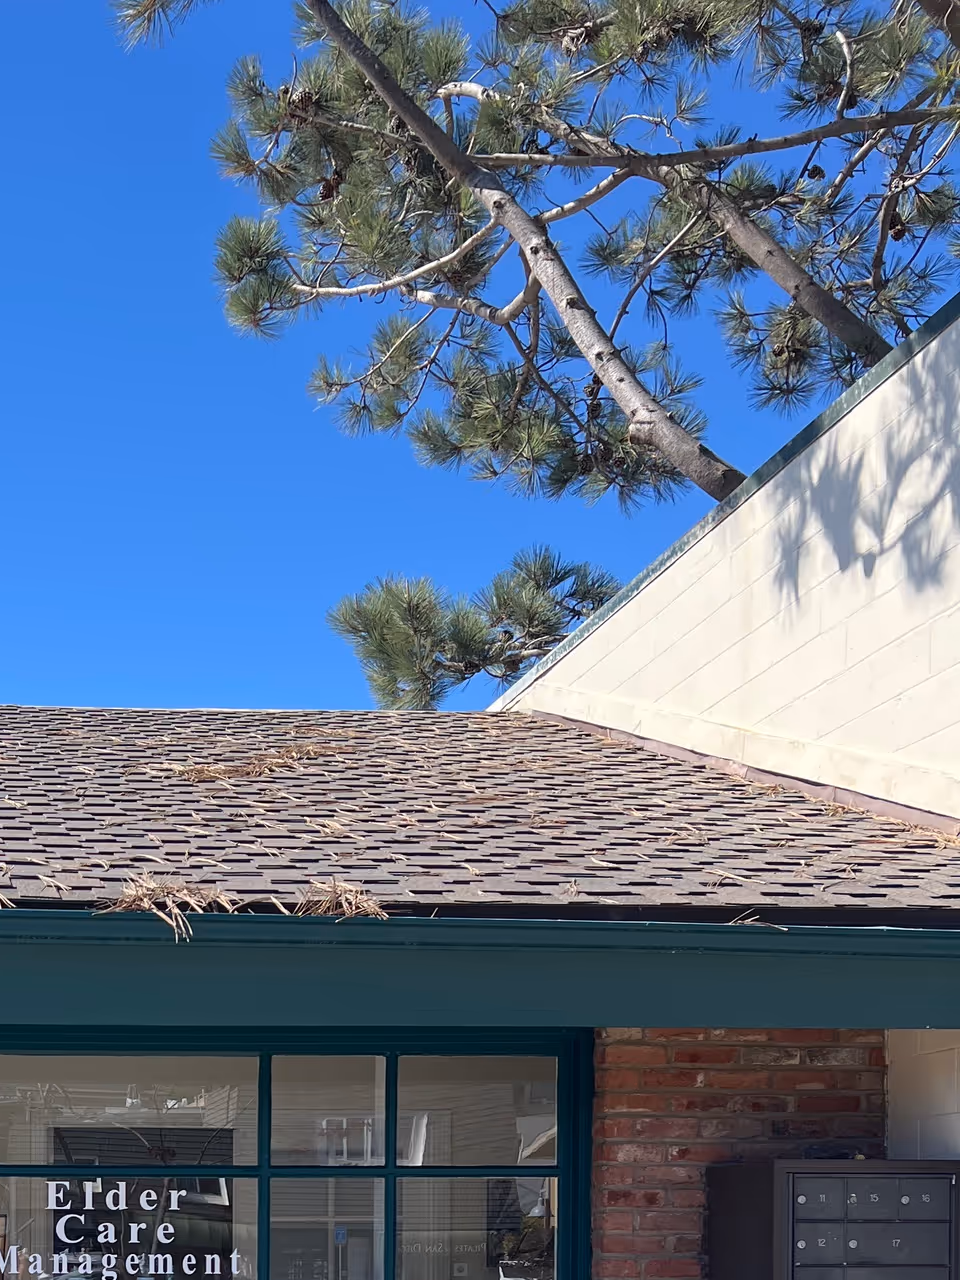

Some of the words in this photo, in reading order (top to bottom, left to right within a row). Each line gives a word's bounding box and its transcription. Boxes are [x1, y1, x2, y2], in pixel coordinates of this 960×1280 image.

[45, 1181, 187, 1211] Elder
[819, 1194, 826, 1202] 11
[869, 1194, 879, 1202] 15
[921, 1194, 931, 1203] 16
[55, 1213, 175, 1244] Care
[817, 1238, 827, 1247] 12
[892, 1239, 901, 1248] 17
